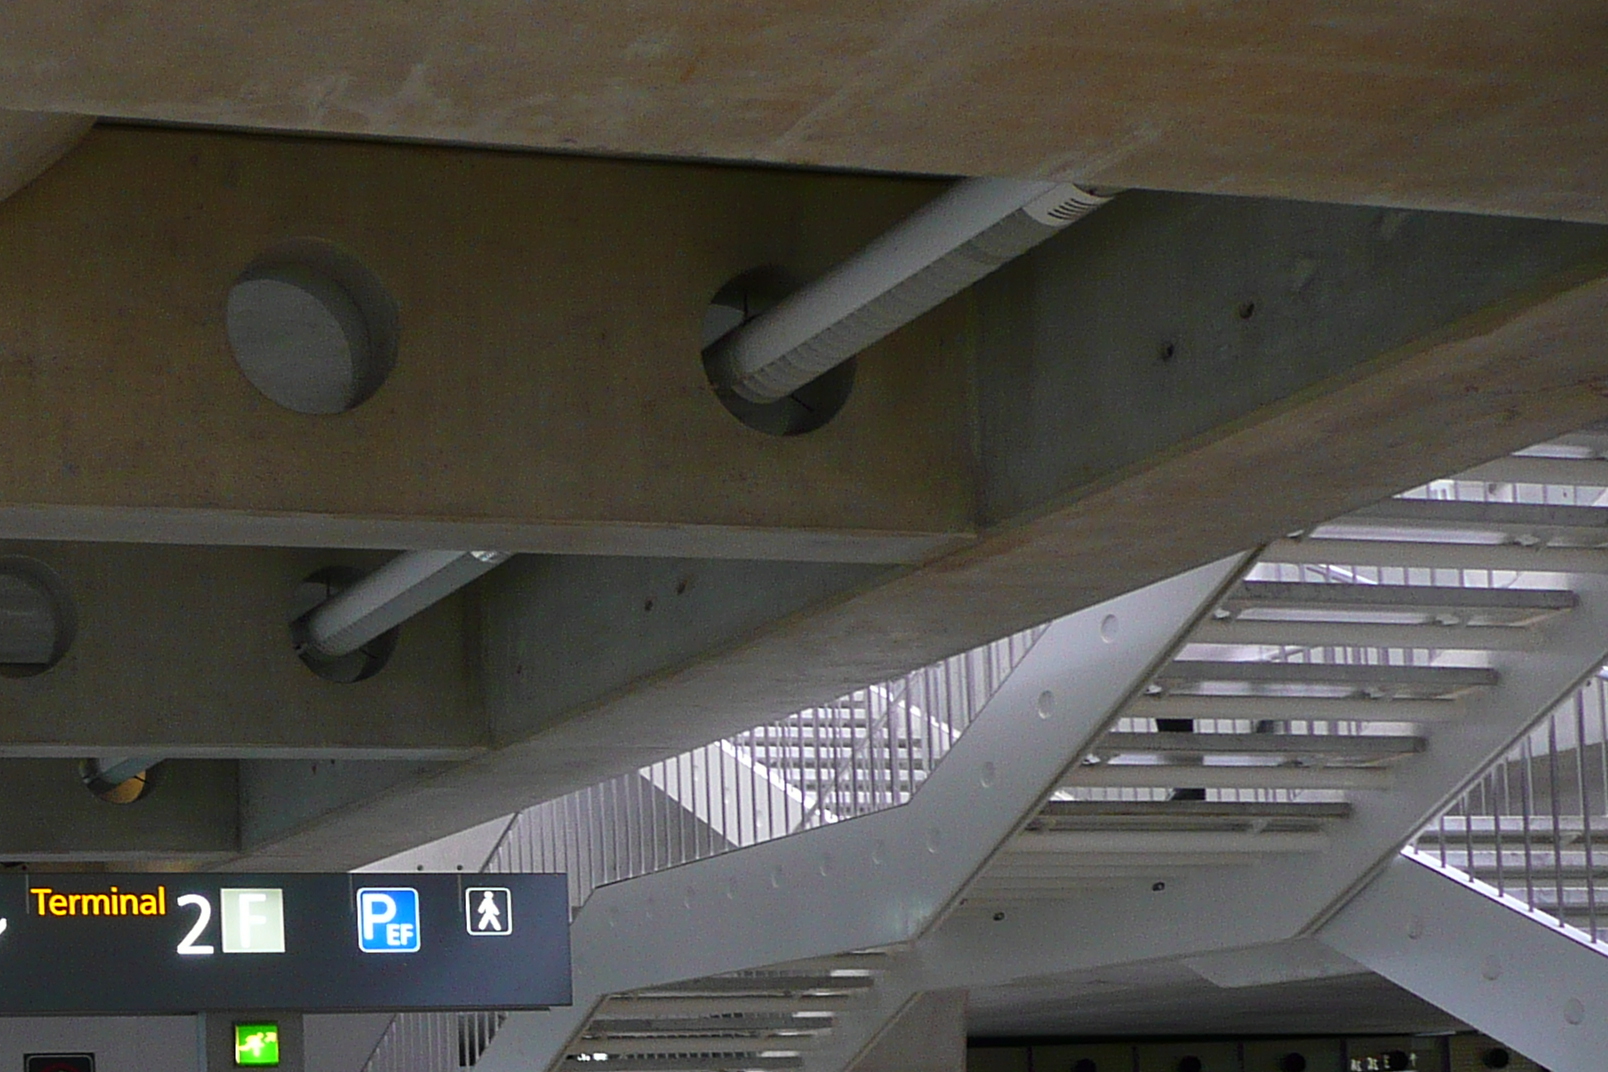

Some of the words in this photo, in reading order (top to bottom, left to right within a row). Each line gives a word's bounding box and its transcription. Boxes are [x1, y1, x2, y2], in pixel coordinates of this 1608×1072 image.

[31, 886, 166, 916] Terminal
[361, 892, 397, 940] P
[385, 922, 415, 946] EF
